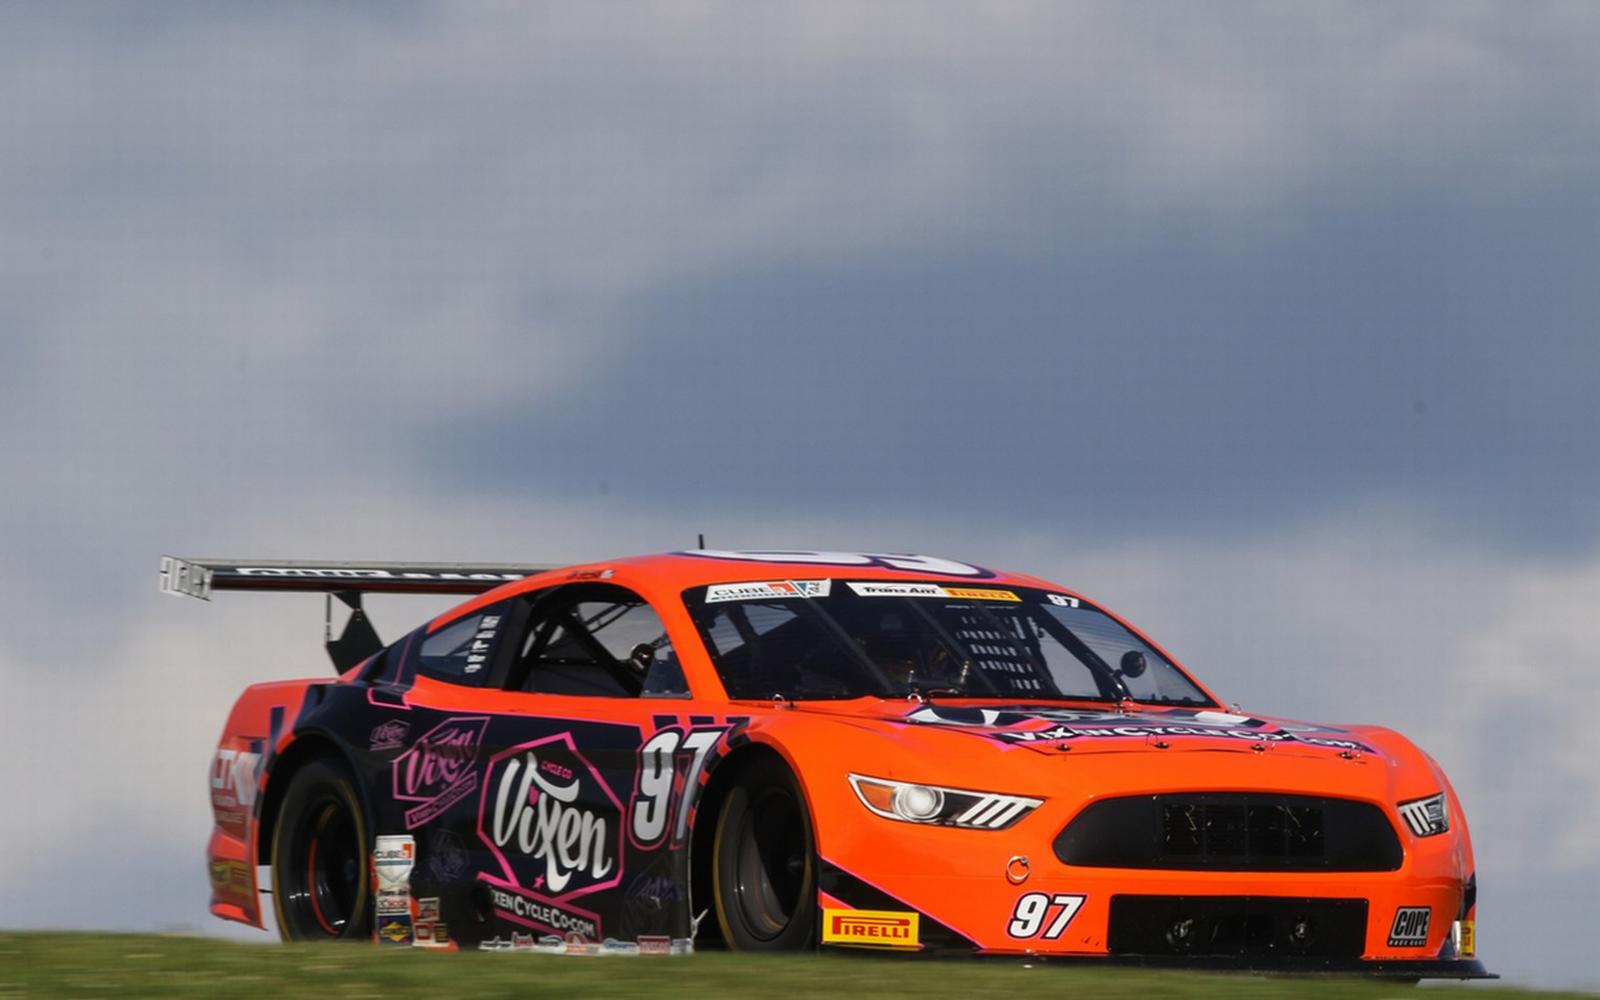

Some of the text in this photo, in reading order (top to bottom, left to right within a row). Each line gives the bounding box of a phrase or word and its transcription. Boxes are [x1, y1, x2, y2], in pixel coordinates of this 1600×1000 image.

[1046, 594, 1080, 609] 97
[633, 730, 723, 842] 97
[493, 751, 613, 893] Vixen
[831, 915, 911, 939] PIRELLI
[1008, 892, 1086, 940] 97
[1393, 910, 1429, 937] COPE
